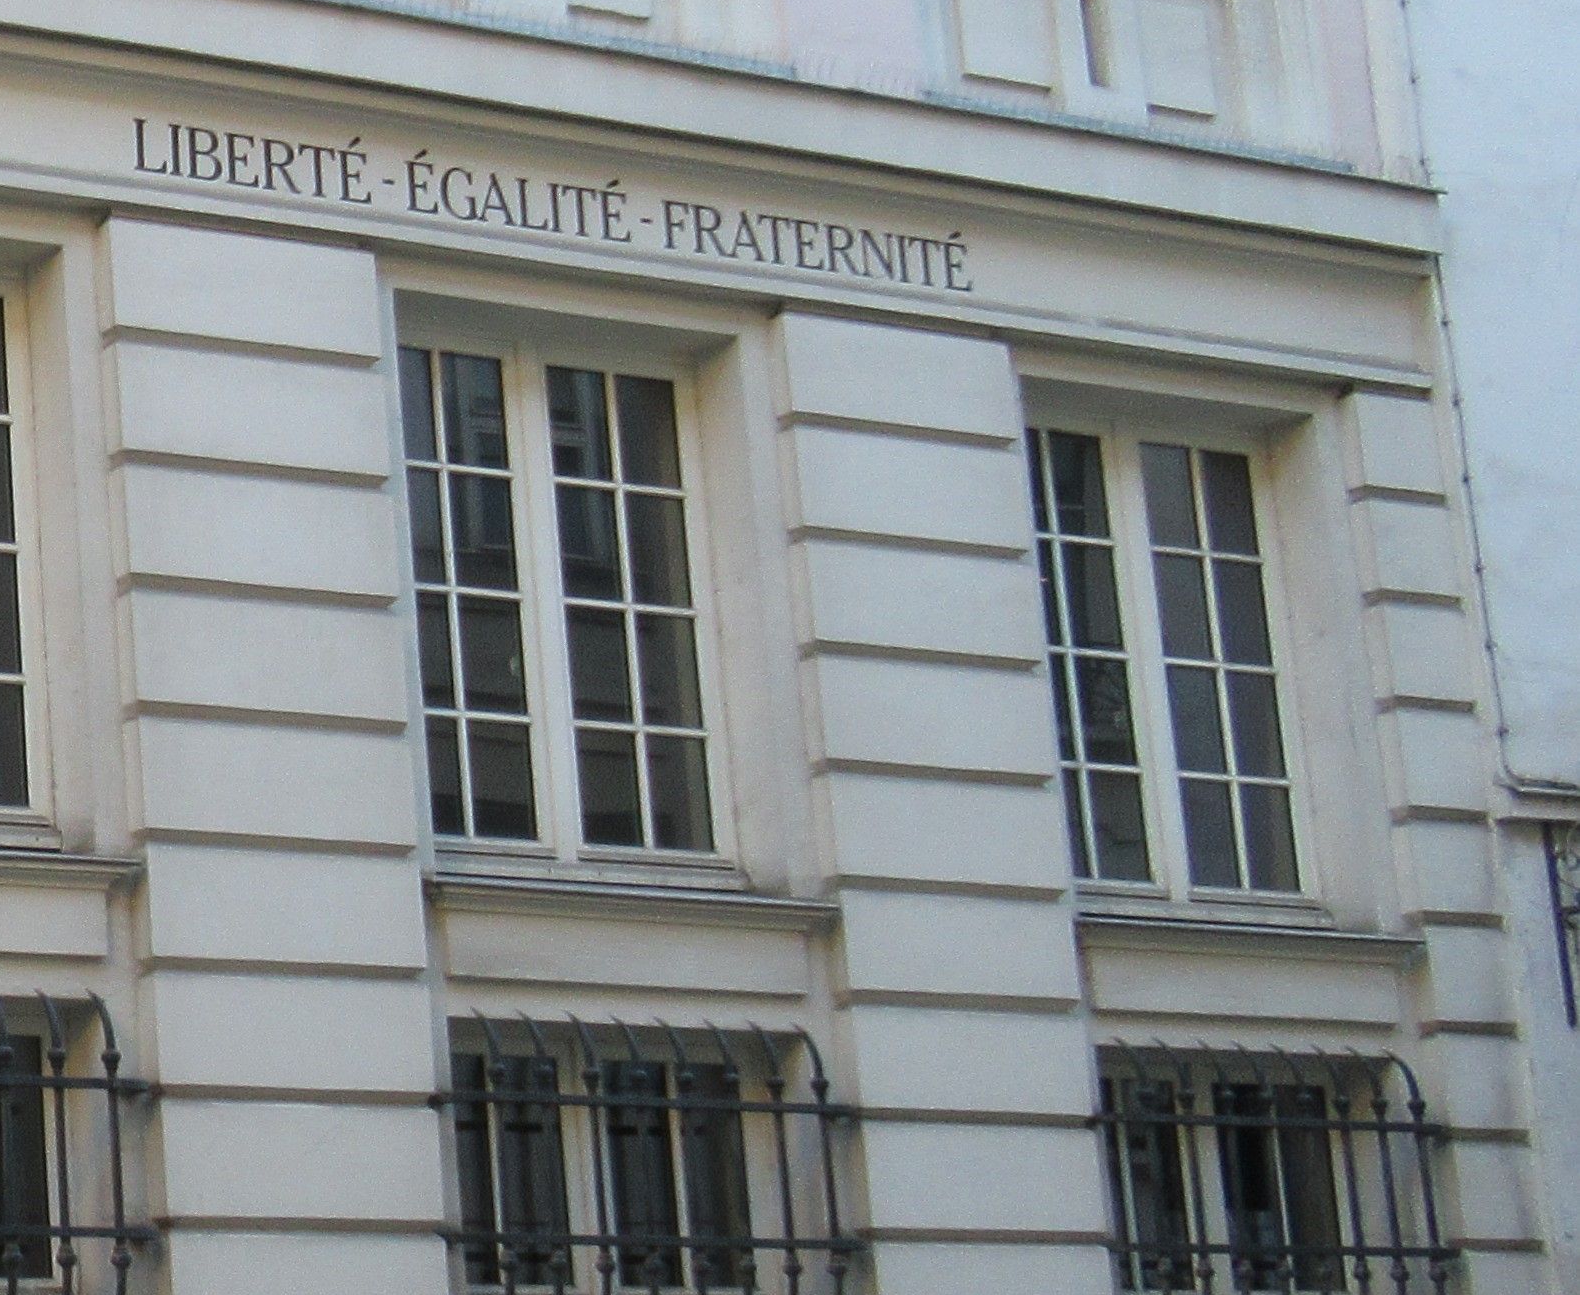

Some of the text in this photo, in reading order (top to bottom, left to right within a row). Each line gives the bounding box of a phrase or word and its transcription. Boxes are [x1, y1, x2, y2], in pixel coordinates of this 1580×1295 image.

[133, 117, 373, 205] LIBERTÉ
[403, 148, 632, 244] ÉGALITÉ
[661, 199, 974, 292] FRATERNITÉ
